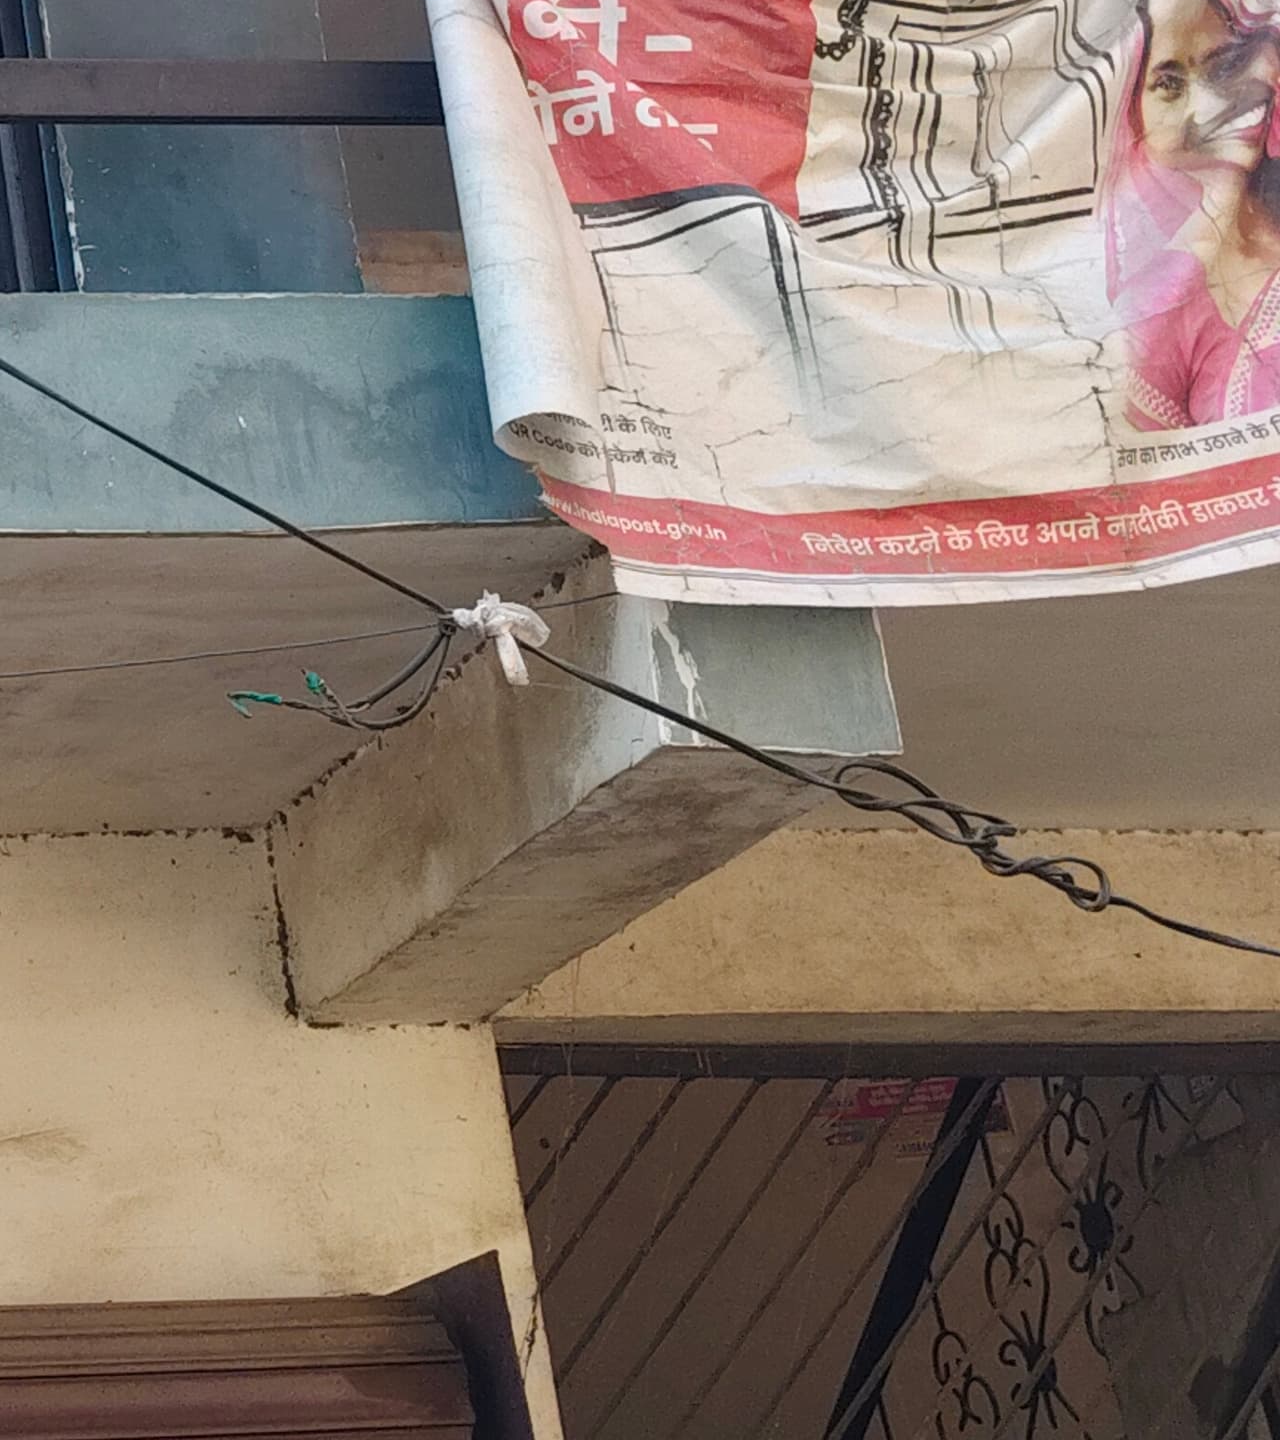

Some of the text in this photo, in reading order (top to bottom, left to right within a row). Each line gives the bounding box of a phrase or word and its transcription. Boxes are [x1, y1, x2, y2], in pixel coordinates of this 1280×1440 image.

[1158, 441, 1199, 462] लाभ
[1197, 427, 1248, 453] उठाने
[802, 531, 873, 557] निवेश
[874, 526, 941, 557] करने
[944, 524, 973, 552] के
[975, 520, 1029, 550] लिए
[1036, 513, 1101, 545] अपने
[1187, 487, 1270, 524] डाकघर
